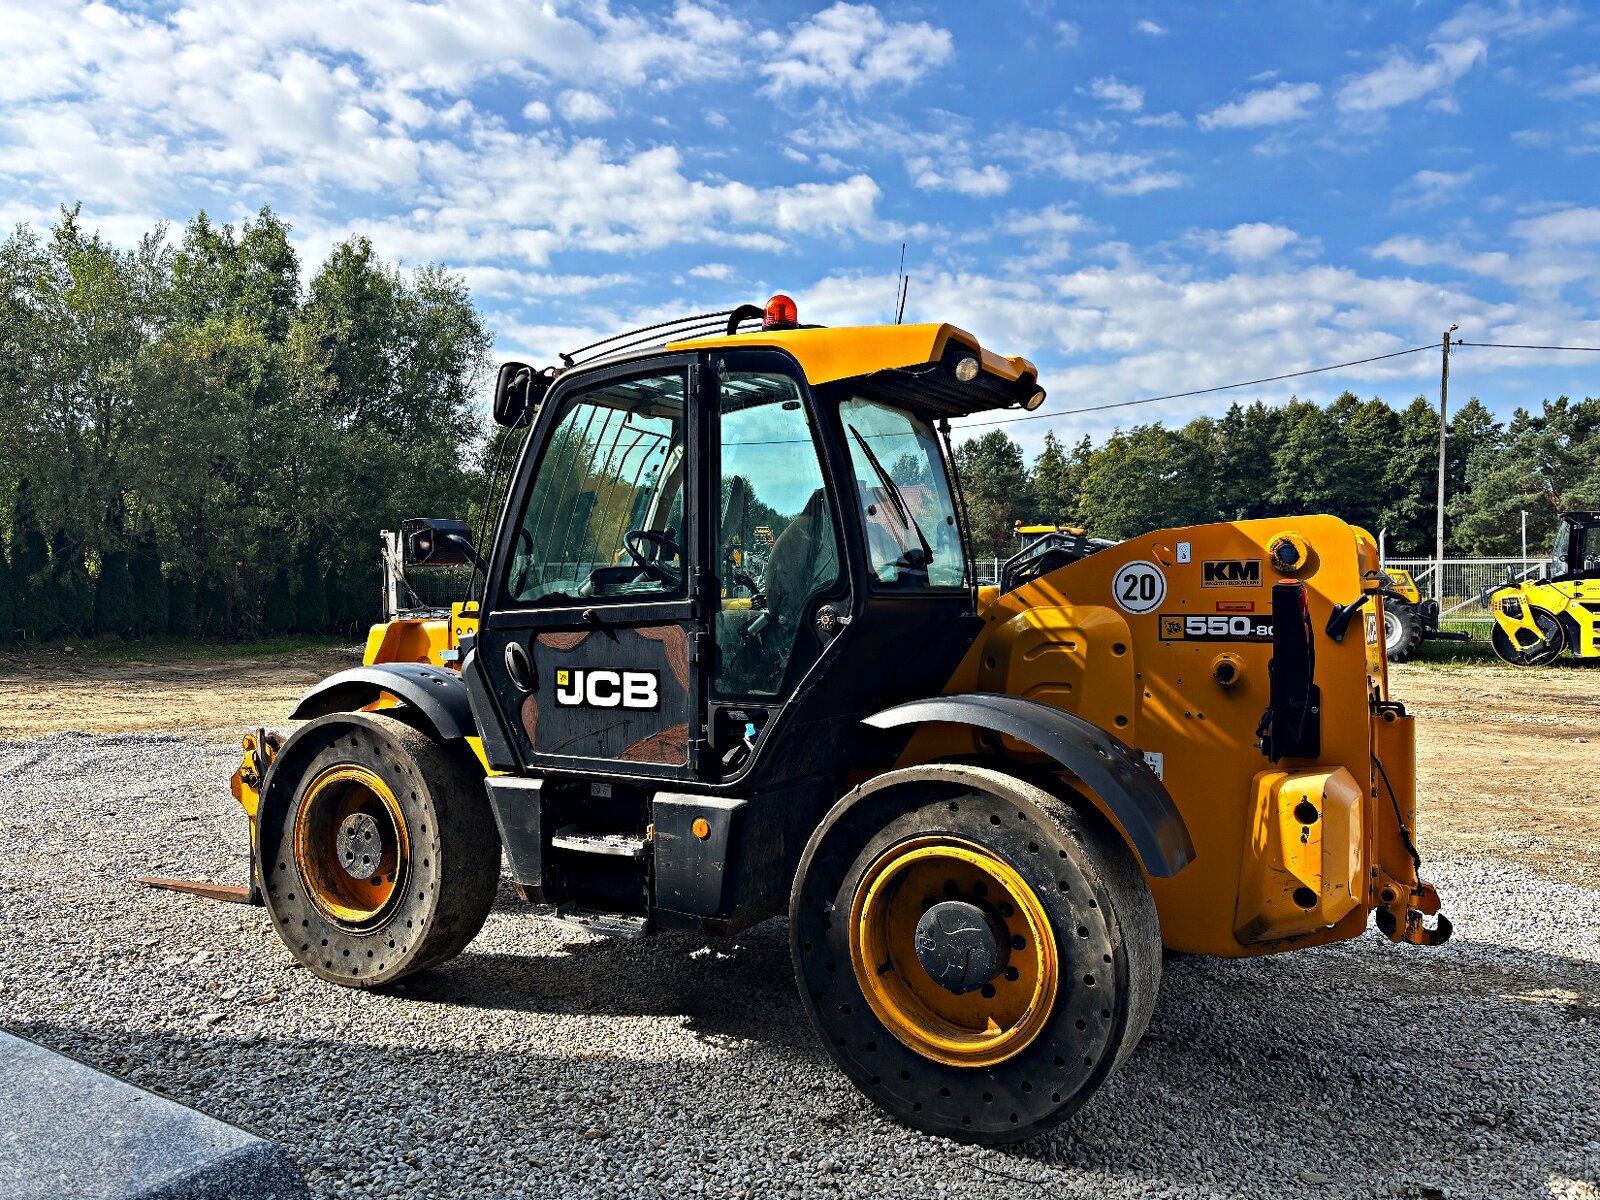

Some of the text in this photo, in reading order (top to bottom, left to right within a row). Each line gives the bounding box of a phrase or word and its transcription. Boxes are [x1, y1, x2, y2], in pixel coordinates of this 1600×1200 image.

[1204, 561, 1260, 581] KM
[1122, 573, 1157, 602] 20
[557, 670, 659, 708] JCB
